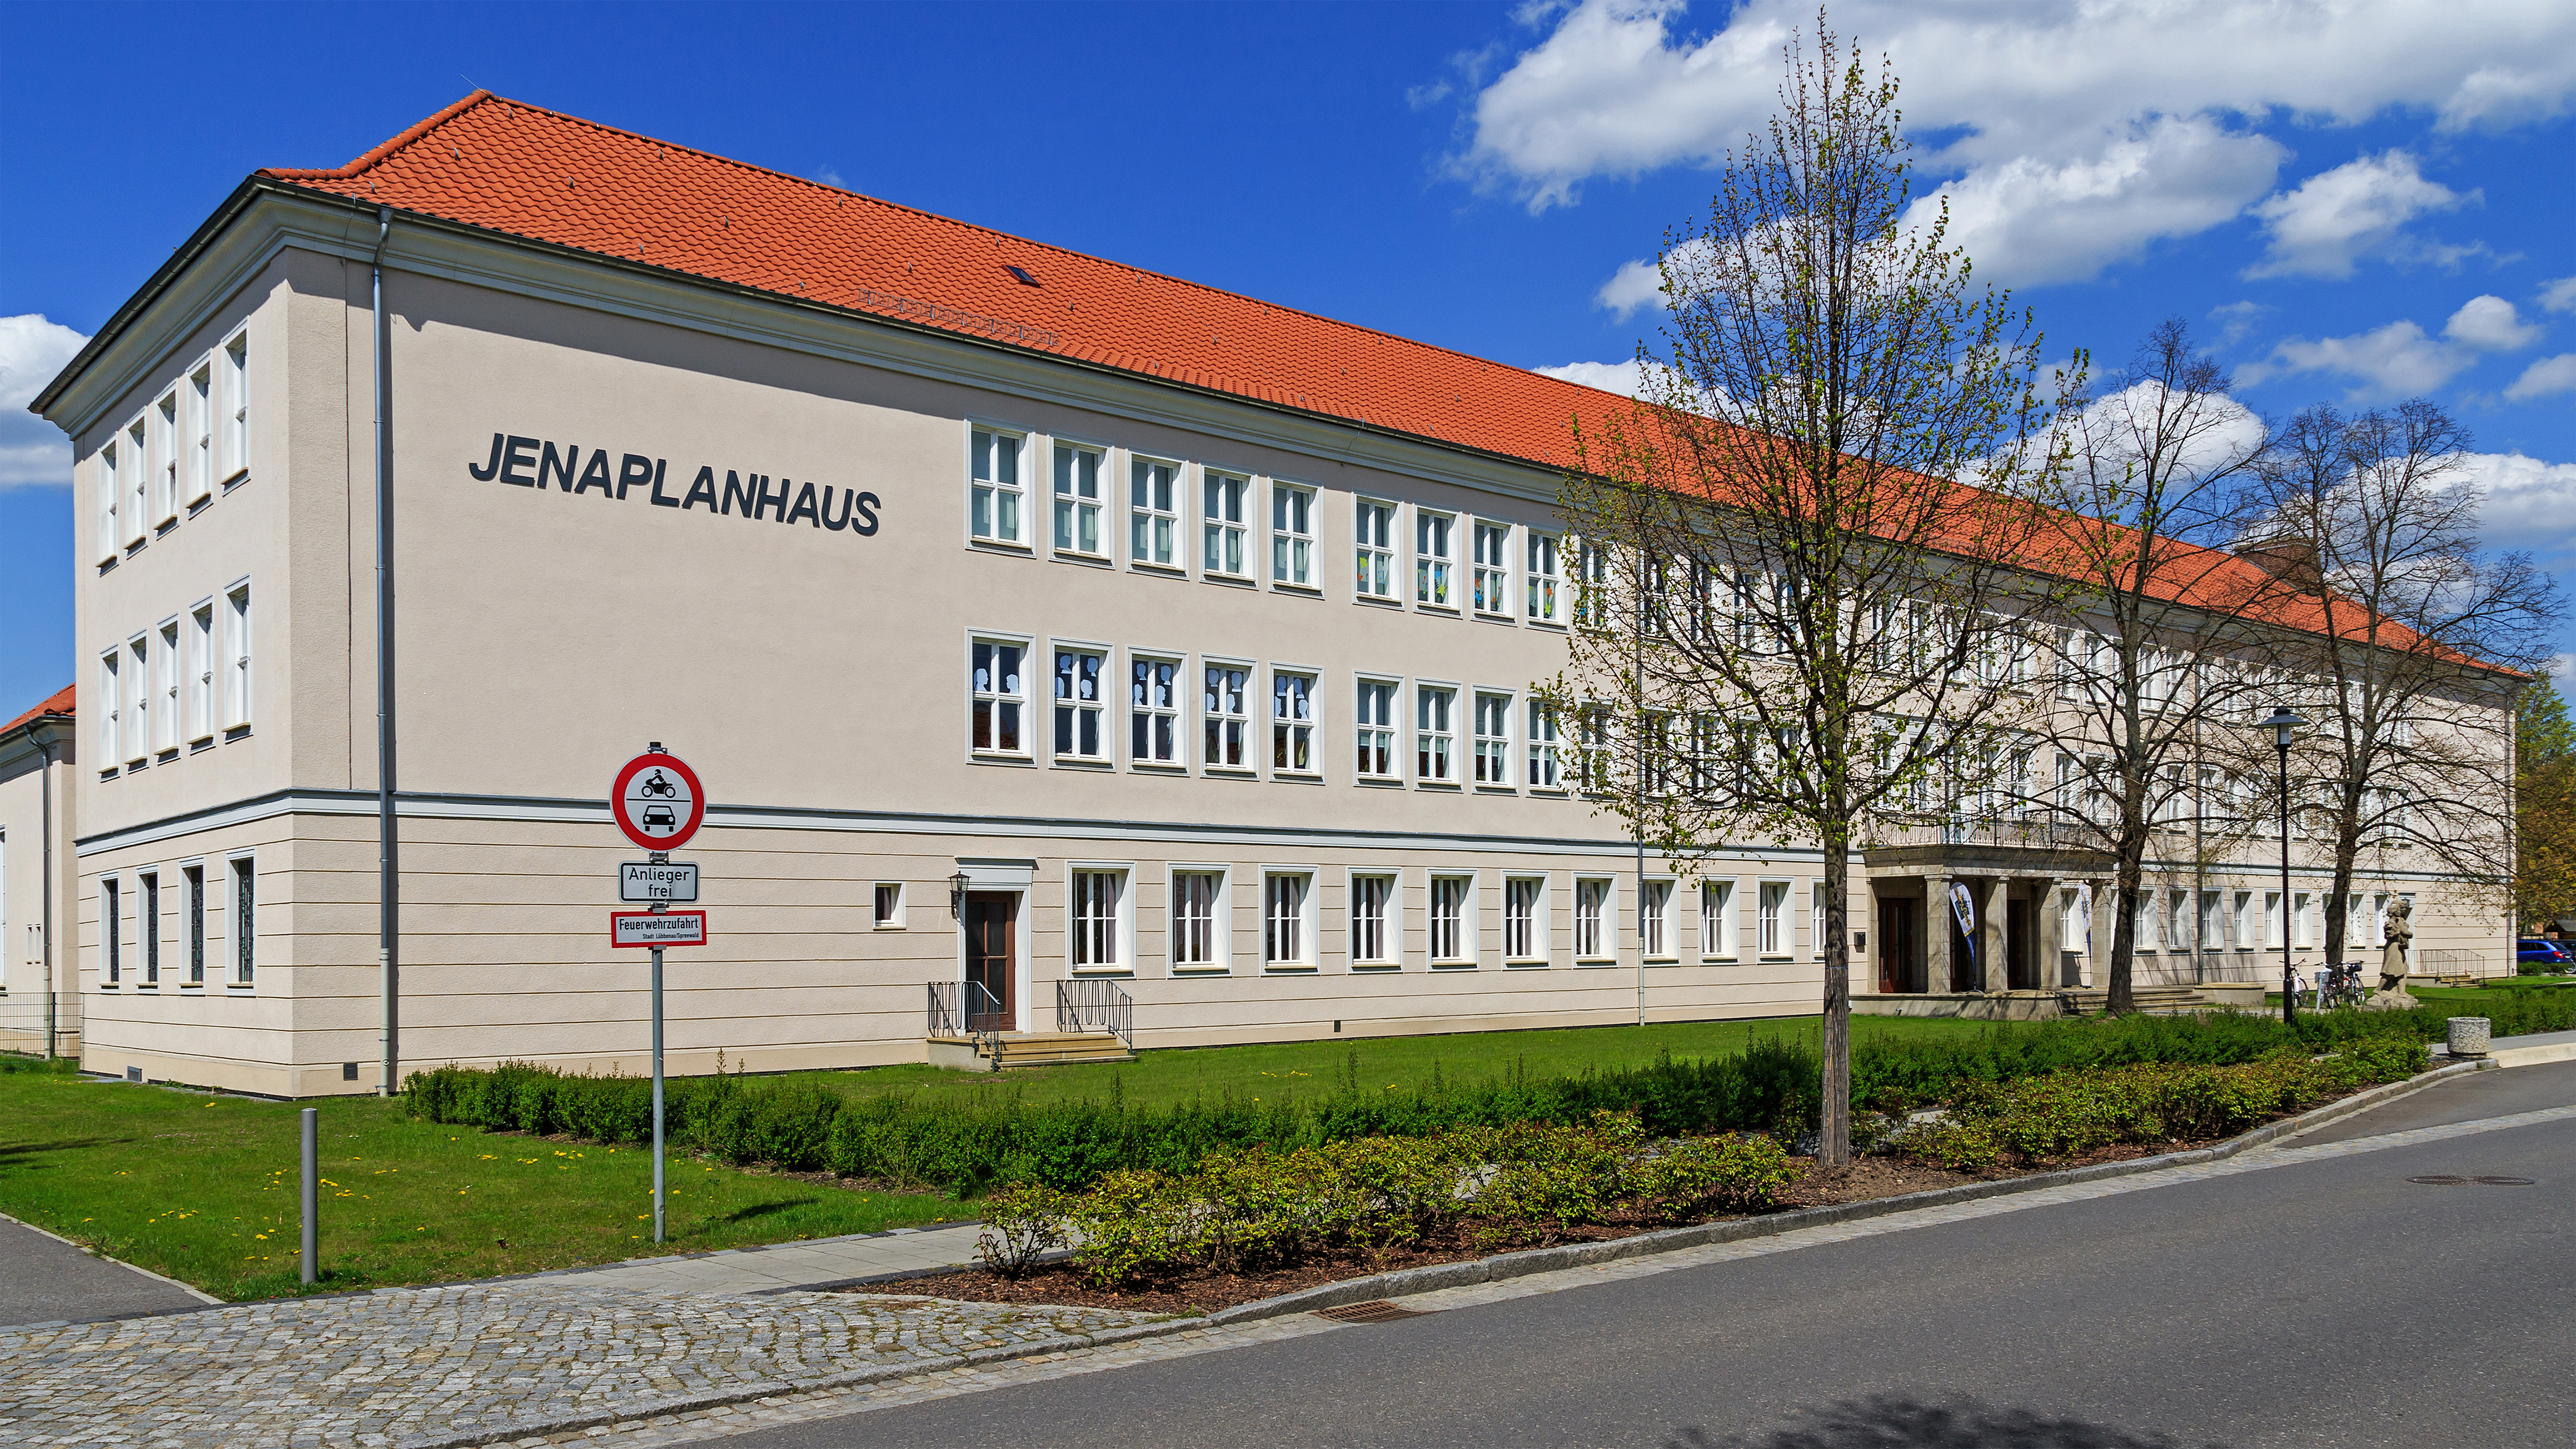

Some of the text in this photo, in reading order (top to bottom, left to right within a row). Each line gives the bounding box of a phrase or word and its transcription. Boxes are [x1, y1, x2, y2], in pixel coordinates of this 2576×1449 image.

[468, 433, 882, 537] JENAPLANHAUS
[629, 867, 690, 884] Anlieger
[648, 884, 672, 897] frei
[619, 918, 698, 930] Feuerwehrzufahrt
